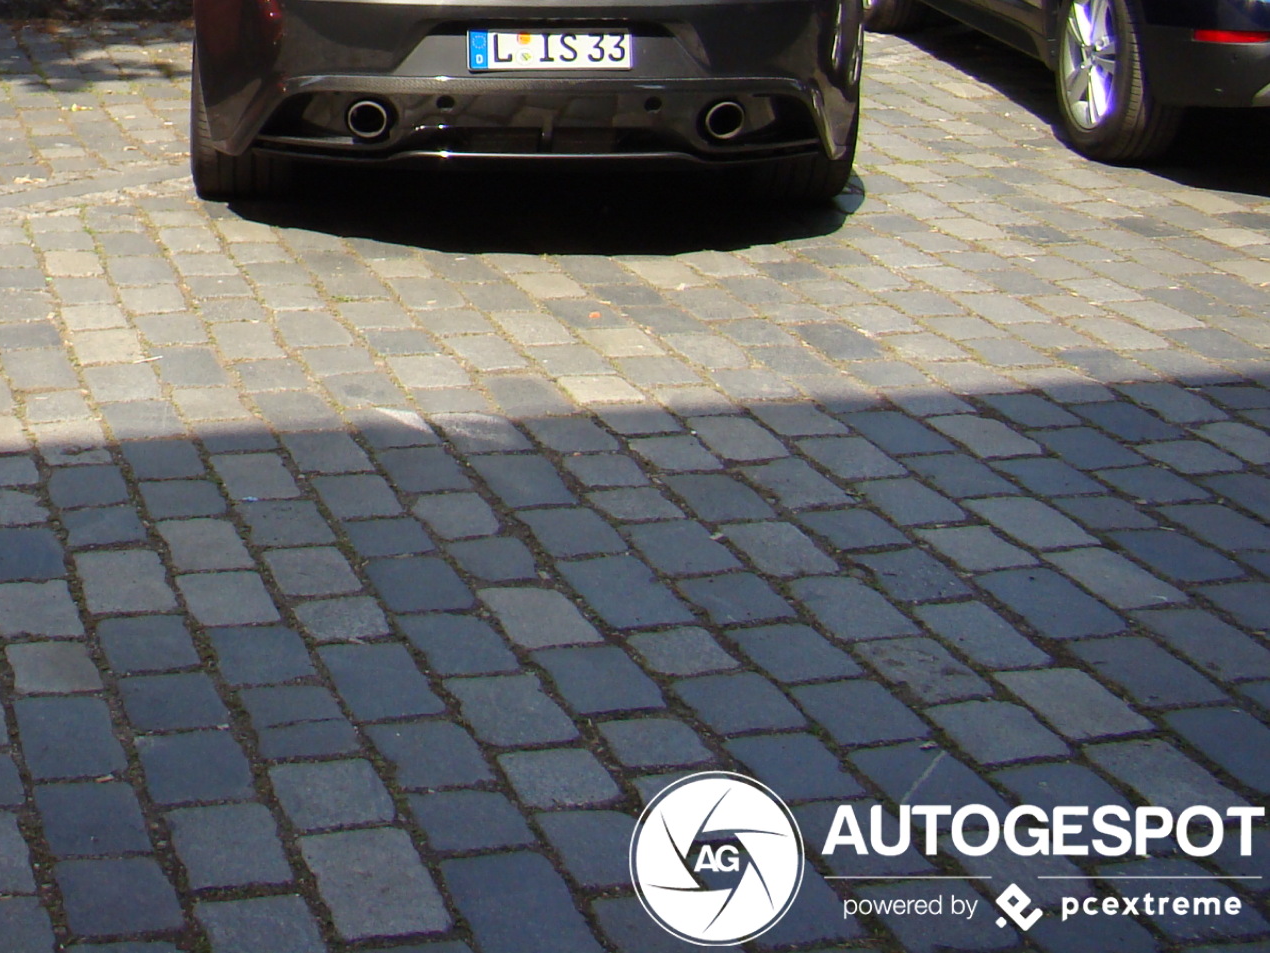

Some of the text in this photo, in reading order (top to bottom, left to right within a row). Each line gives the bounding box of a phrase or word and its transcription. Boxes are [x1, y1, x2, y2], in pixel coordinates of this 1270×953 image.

[493, 33, 626, 63] L IS 33
[475, 54, 484, 65] D
